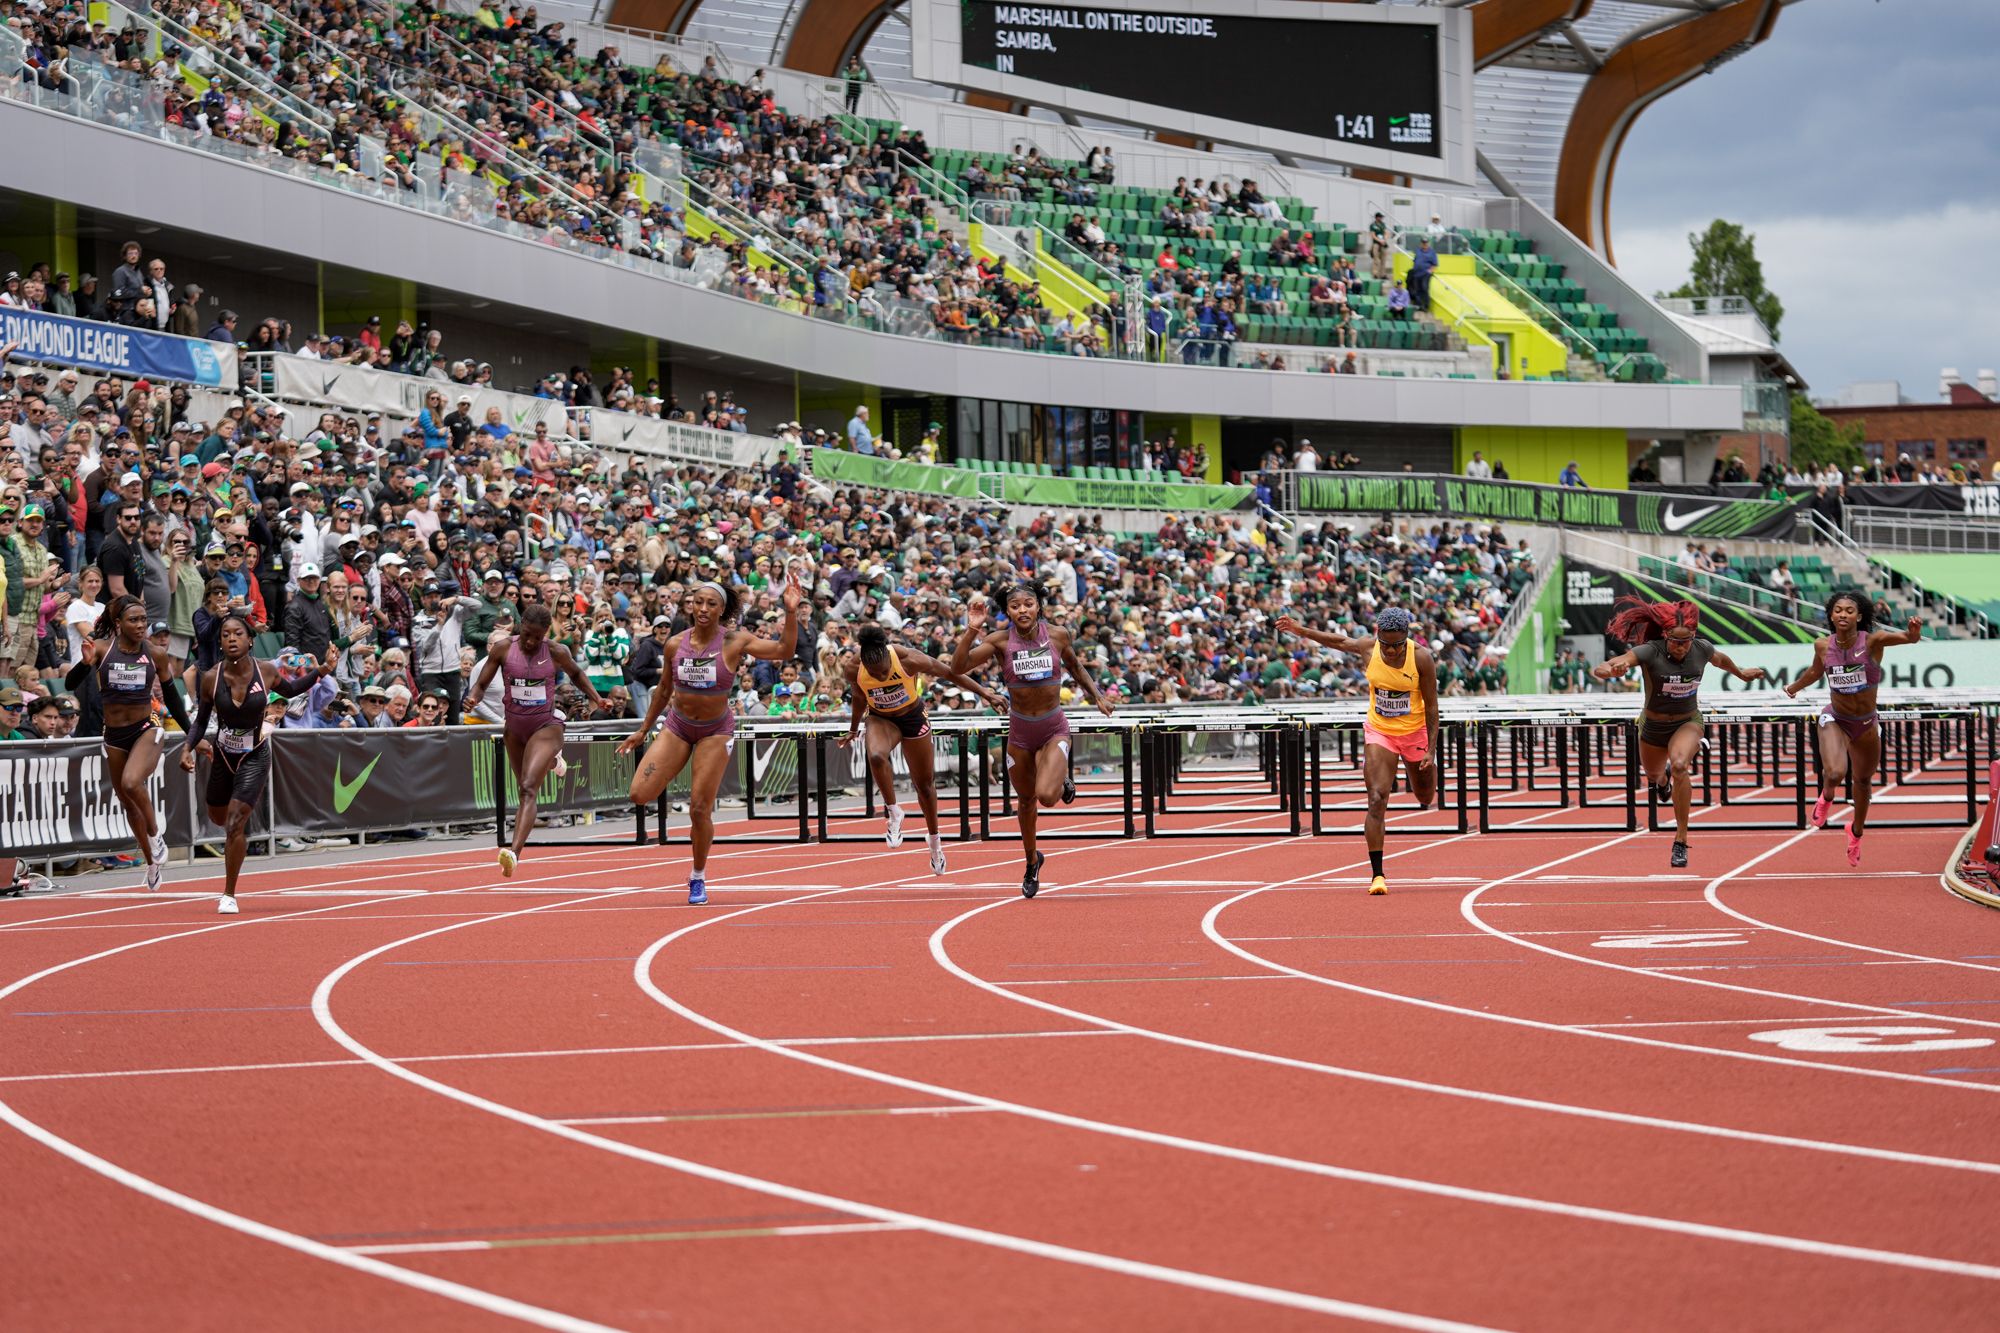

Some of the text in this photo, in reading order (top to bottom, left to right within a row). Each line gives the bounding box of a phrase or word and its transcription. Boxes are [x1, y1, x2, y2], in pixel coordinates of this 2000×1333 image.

[995, 6, 1218, 38] MARSHALL ON THE OUTSIDE,
[996, 30, 1057, 52] SAMBA,
[996, 54, 1014, 72] IN
[1335, 114, 1374, 138] 1:41
[1408, 112, 1432, 128] PRE
[1389, 127, 1432, 142] CLASSIC
[6, 316, 74, 358] DIAMOND
[77, 327, 130, 366] LEAGUE
[1312, 477, 1345, 509] LIVING
[1346, 478, 1400, 510] MEMORIAL
[1402, 479, 1416, 510] TO
[1962, 486, 2000, 515] THE
[1446, 480, 1622, 526] HIS INSPIRATION, HIS AMBITION.
[1567, 571, 1591, 588] PRE
[1567, 587, 1614, 605] CLASSIC
[1017, 650, 1029, 659] PRE
[1015, 659, 1051, 671] MARSHALL
[1833, 666, 1844, 674] PRE
[1833, 674, 1862, 684] RUSSELL
[875, 690, 905, 702] WILLIAMS
[1376, 697, 1408, 709] CHARLTON
[225, 740, 244, 748] MAYELA
[0, 757, 74, 848] TAINE
[1748, 1026, 1996, 1052] 3
